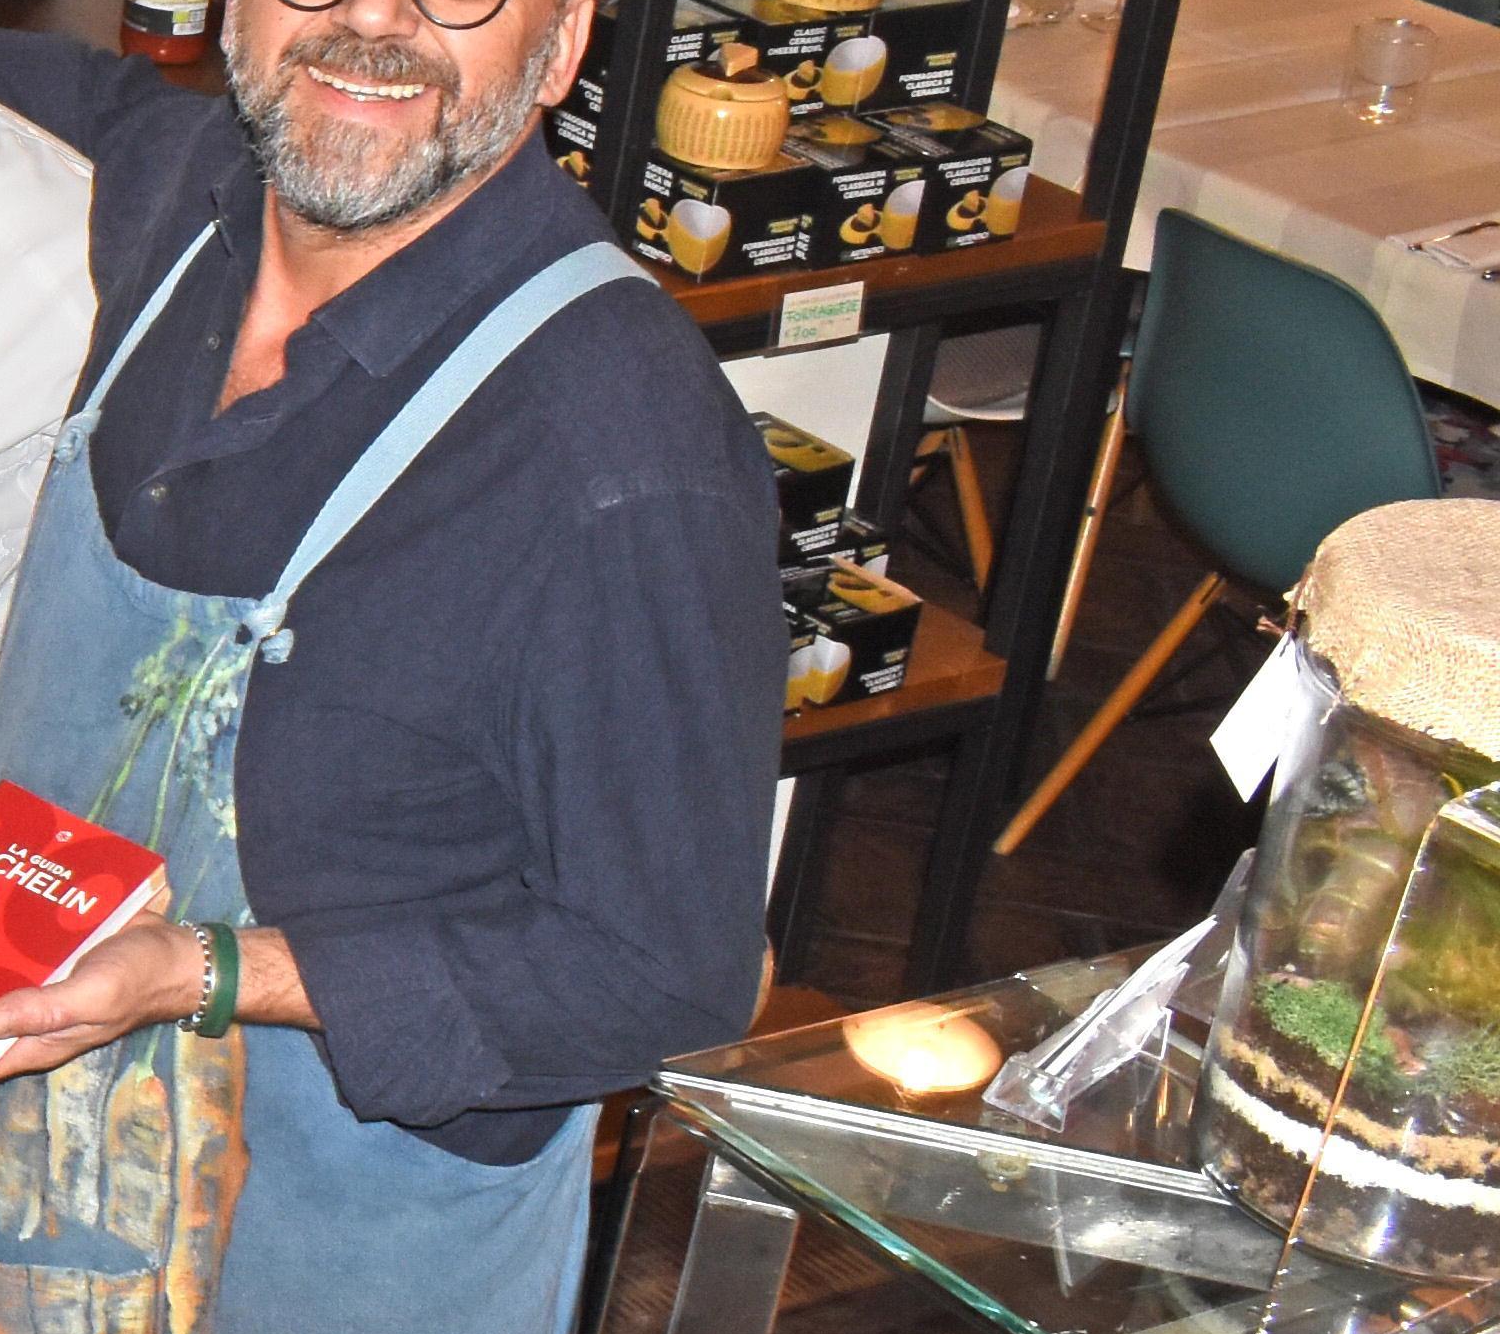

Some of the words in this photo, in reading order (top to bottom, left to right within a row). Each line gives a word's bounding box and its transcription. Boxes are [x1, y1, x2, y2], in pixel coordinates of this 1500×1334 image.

[793, 26, 828, 37] CLASSIC
[7, 842, 28, 859] LA
[30, 853, 73, 880] GUIDA
